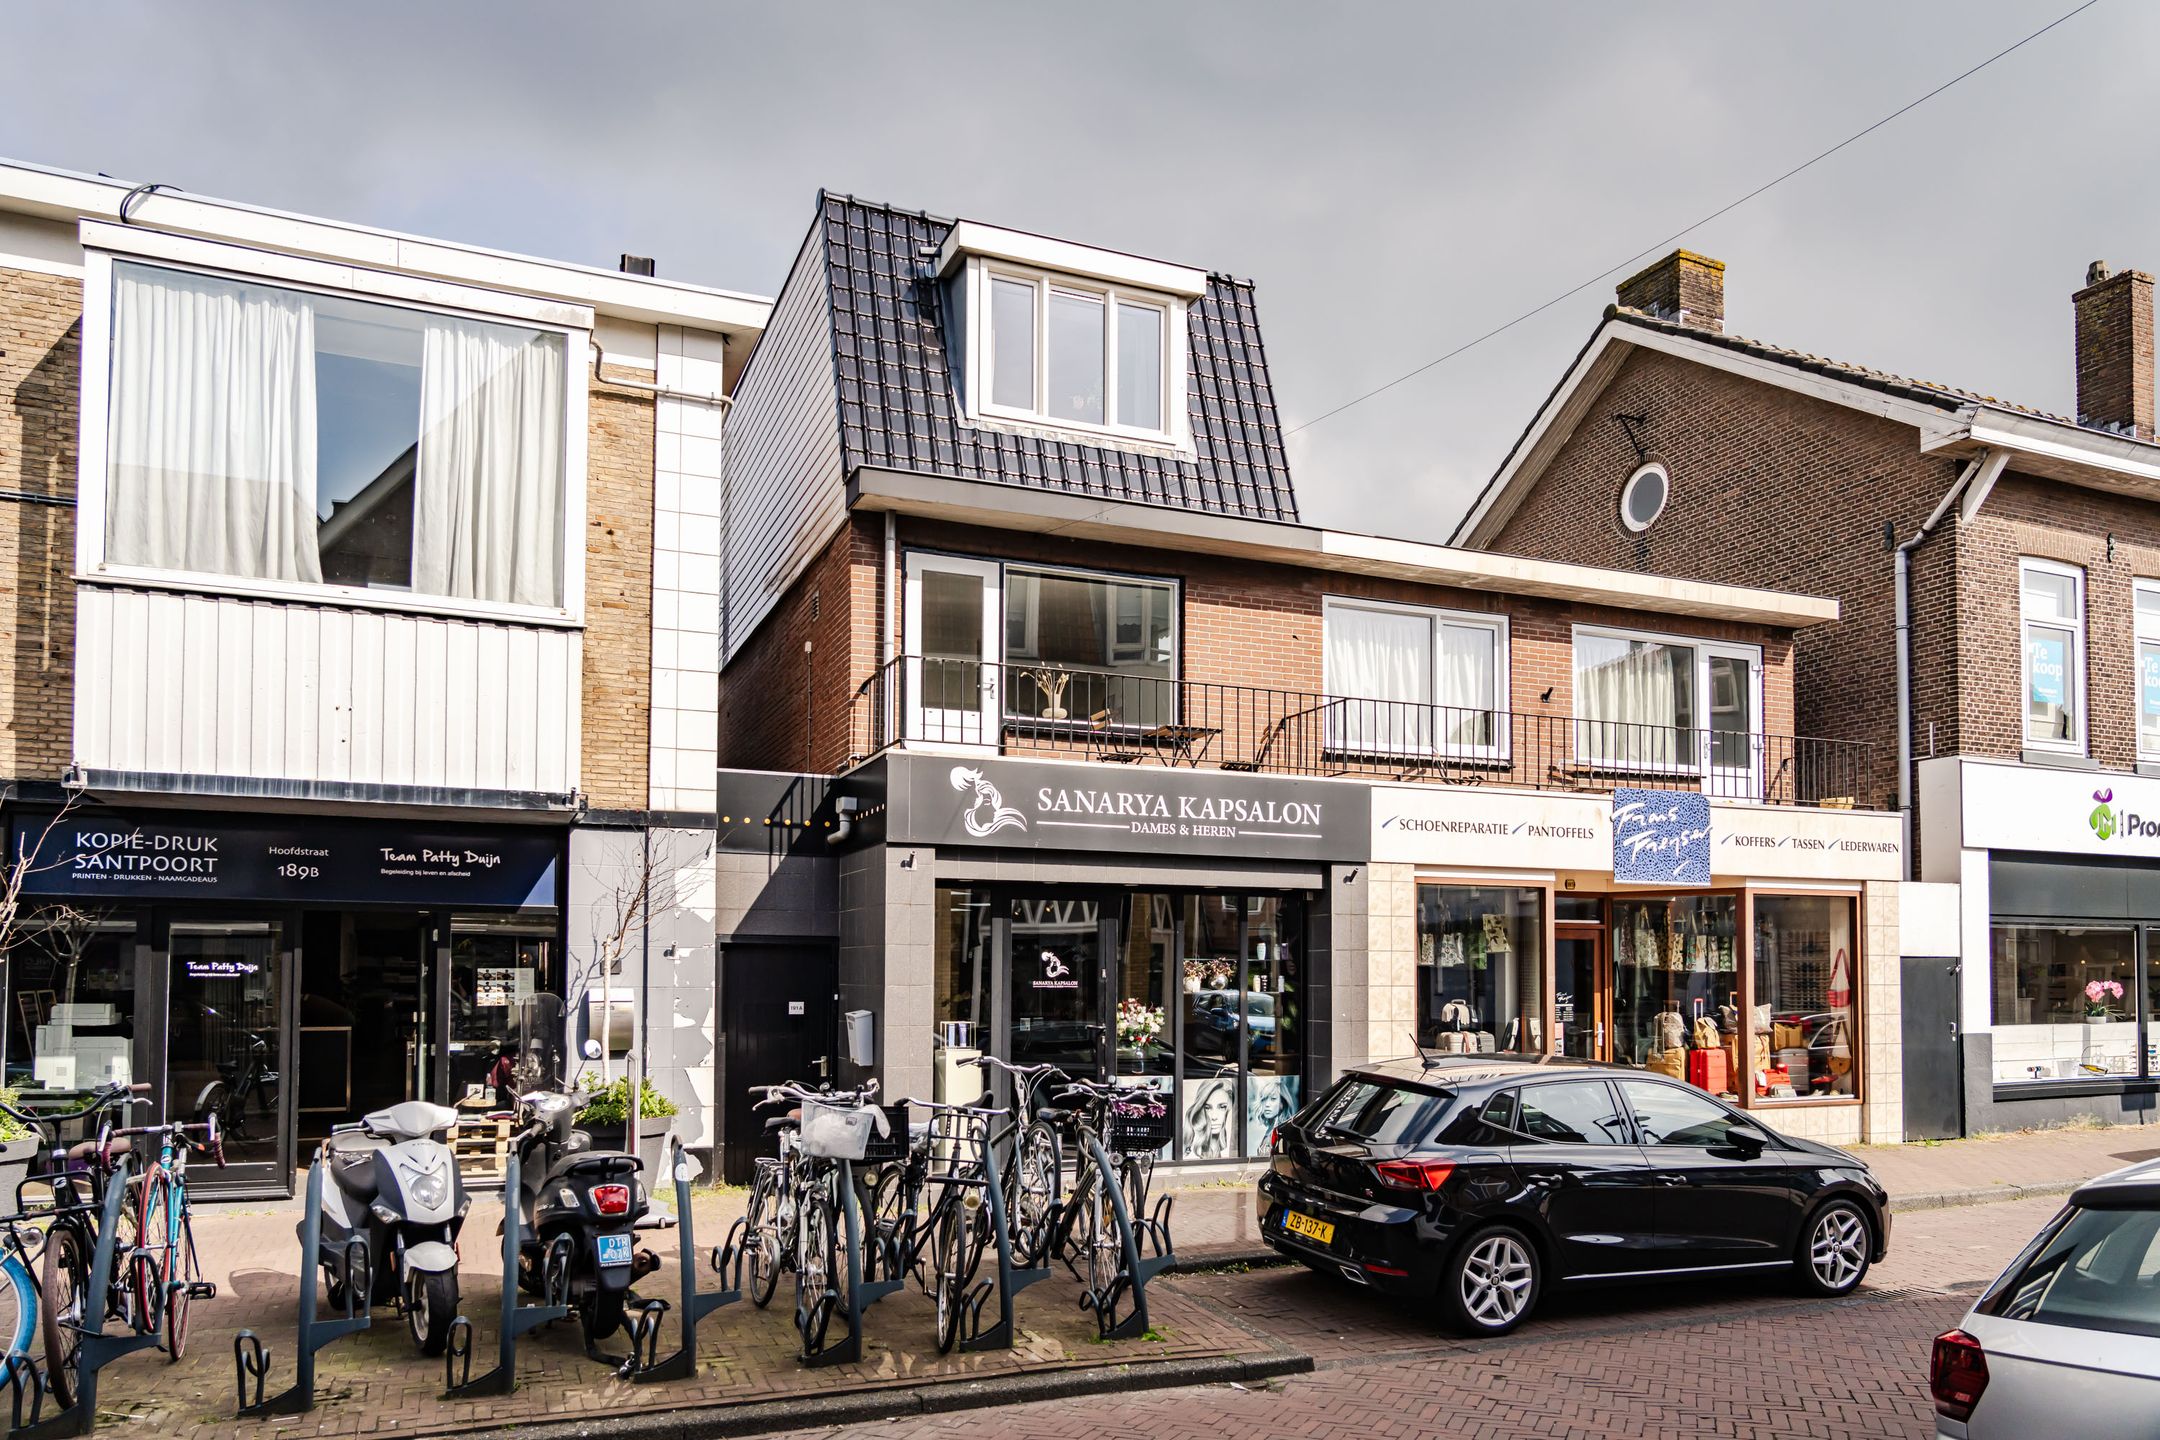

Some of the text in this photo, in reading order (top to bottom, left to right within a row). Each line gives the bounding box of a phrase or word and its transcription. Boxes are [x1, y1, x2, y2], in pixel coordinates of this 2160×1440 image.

[2031, 642, 2048, 659] Te
[2033, 656, 2063, 681] koop
[2144, 656, 2159, 673] Te
[2144, 669, 2160, 688] ko
[1037, 787, 1322, 826] SANARYA KAPSALON
[1131, 821, 1236, 838] DAMES & HEREN
[1399, 818, 1595, 840] SCHOENREPARATIE PANTOFFELS
[2127, 813, 2160, 838] Pro
[268, 846, 329, 857] Hoofdstraat
[1735, 835, 1899, 854] KOFFERS TASSEN LEDERWAREN
[74, 853, 219, 873] SANTPOORT
[380, 847, 501, 868] Team Patty Duijn
[72, 872, 107, 880] PRINTEN
[158, 875, 218, 883] NAAMCADEAUS
[277, 863, 320, 880] 189B
[380, 868, 414, 876] Begeleiding
[186, 961, 210, 970] Team
[211, 961, 235, 973] Patty
[1289, 1214, 1328, 1240] ZB-137-K
